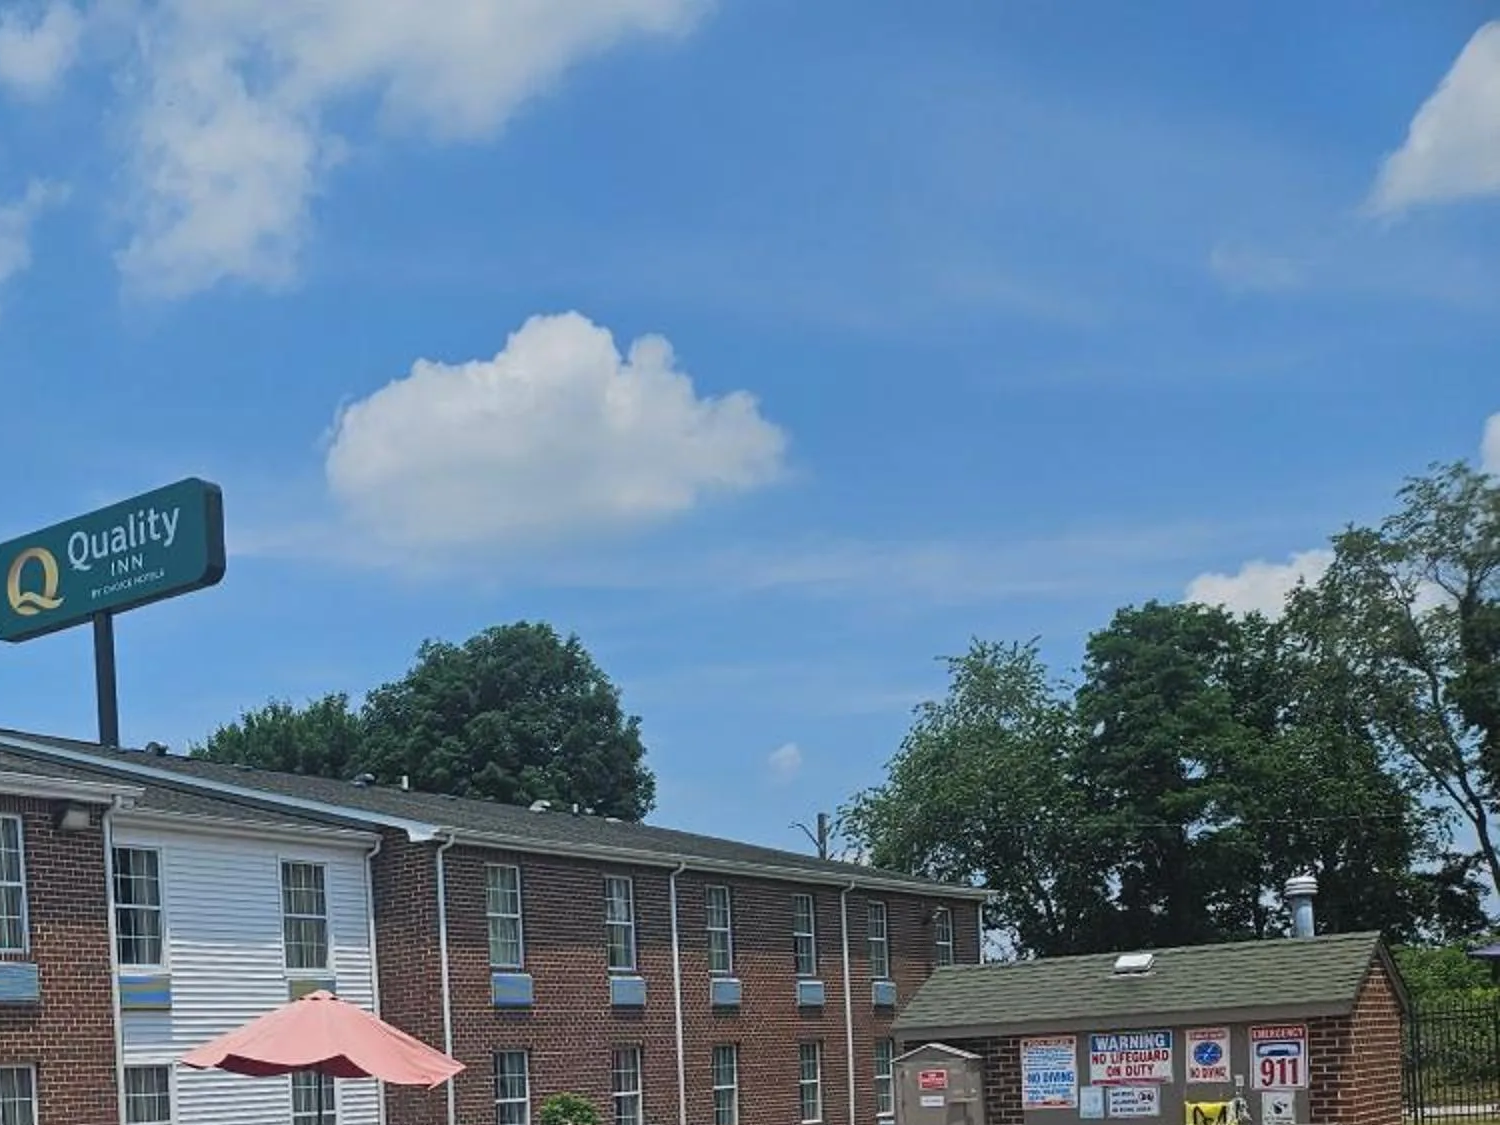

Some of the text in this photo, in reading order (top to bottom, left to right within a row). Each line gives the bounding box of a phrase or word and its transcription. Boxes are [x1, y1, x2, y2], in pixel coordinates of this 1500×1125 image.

[67, 507, 180, 571] Quality
[111, 553, 143, 577] INN
[7, 547, 65, 616] Q
[1094, 1033, 1165, 1051] WARNING
[1091, 1049, 1169, 1065] NO LIFEGUARD
[1106, 1063, 1154, 1077] ON DUTY
[1261, 1057, 1298, 1087] 911
